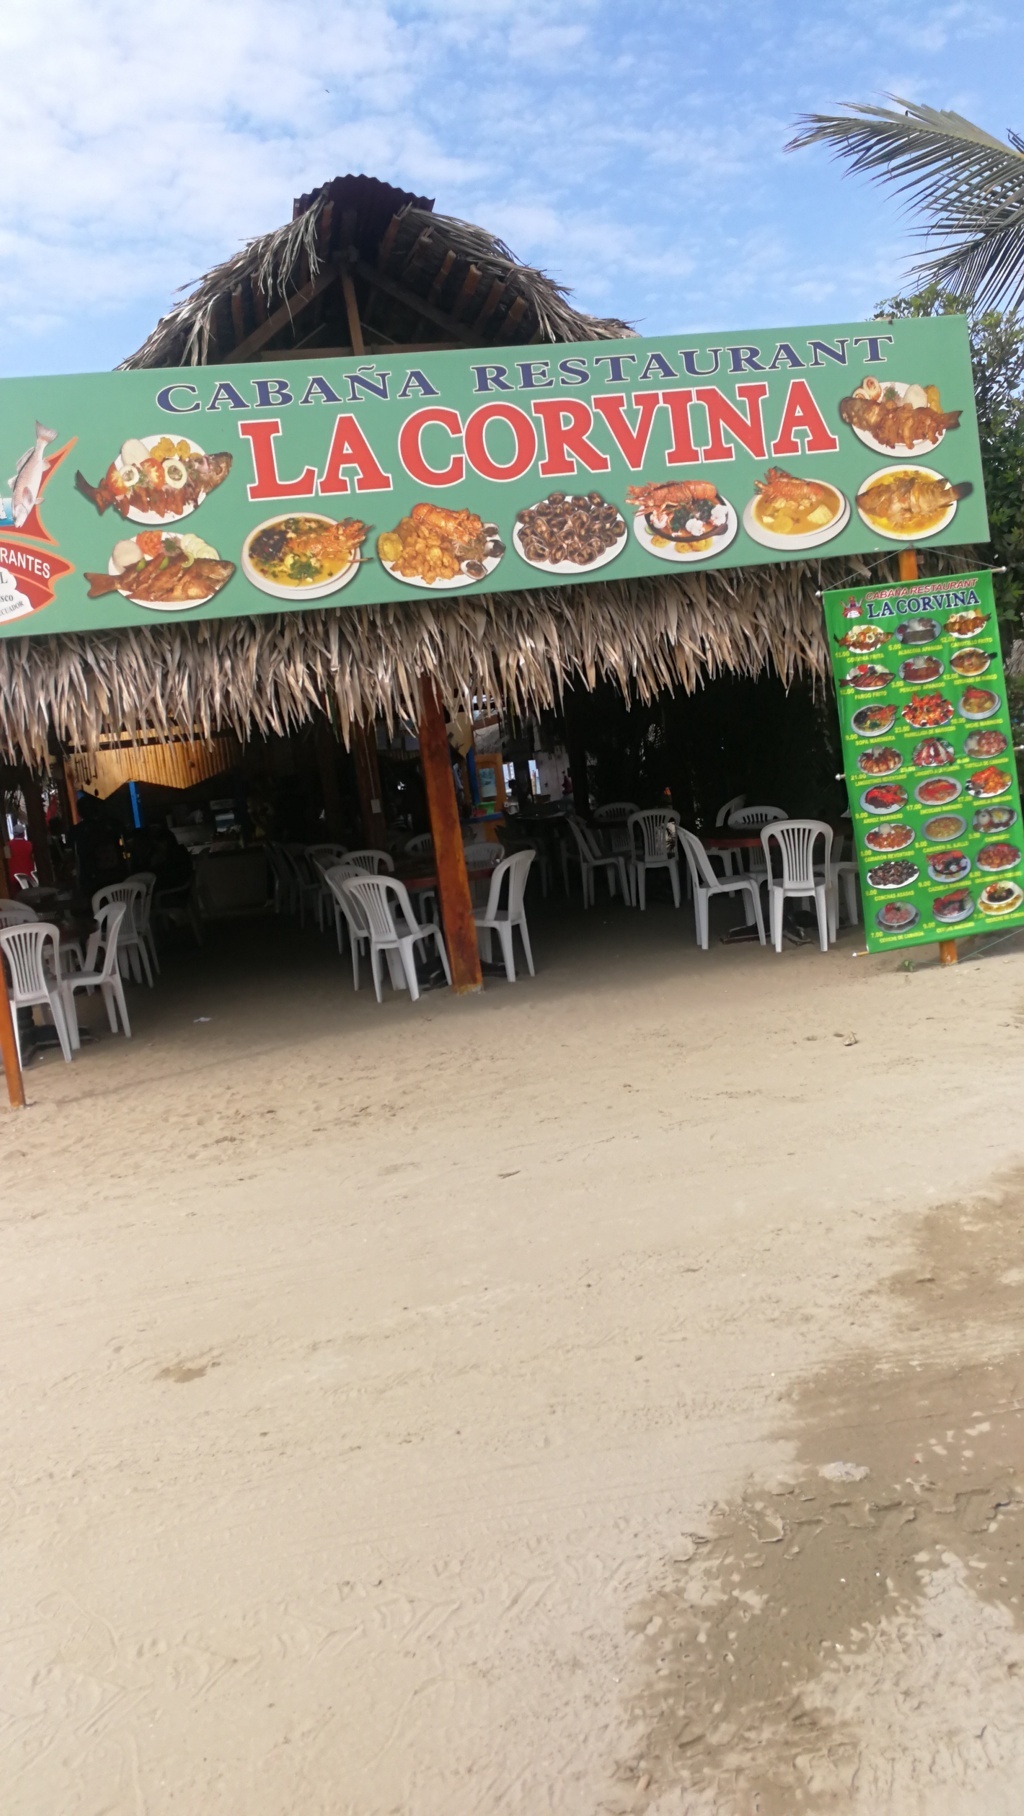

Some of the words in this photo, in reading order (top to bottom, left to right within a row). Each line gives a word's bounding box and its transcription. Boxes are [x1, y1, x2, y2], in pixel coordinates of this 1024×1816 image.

[156, 364, 439, 414] CABAÑA
[470, 335, 894, 393] RESTAURANT
[237, 413, 394, 501] LA
[397, 378, 840, 488] CORVINA
[866, 601, 895, 619] LA
[896, 589, 981, 614] CORVINA
[909, 578, 979, 596] RESTAURANT
